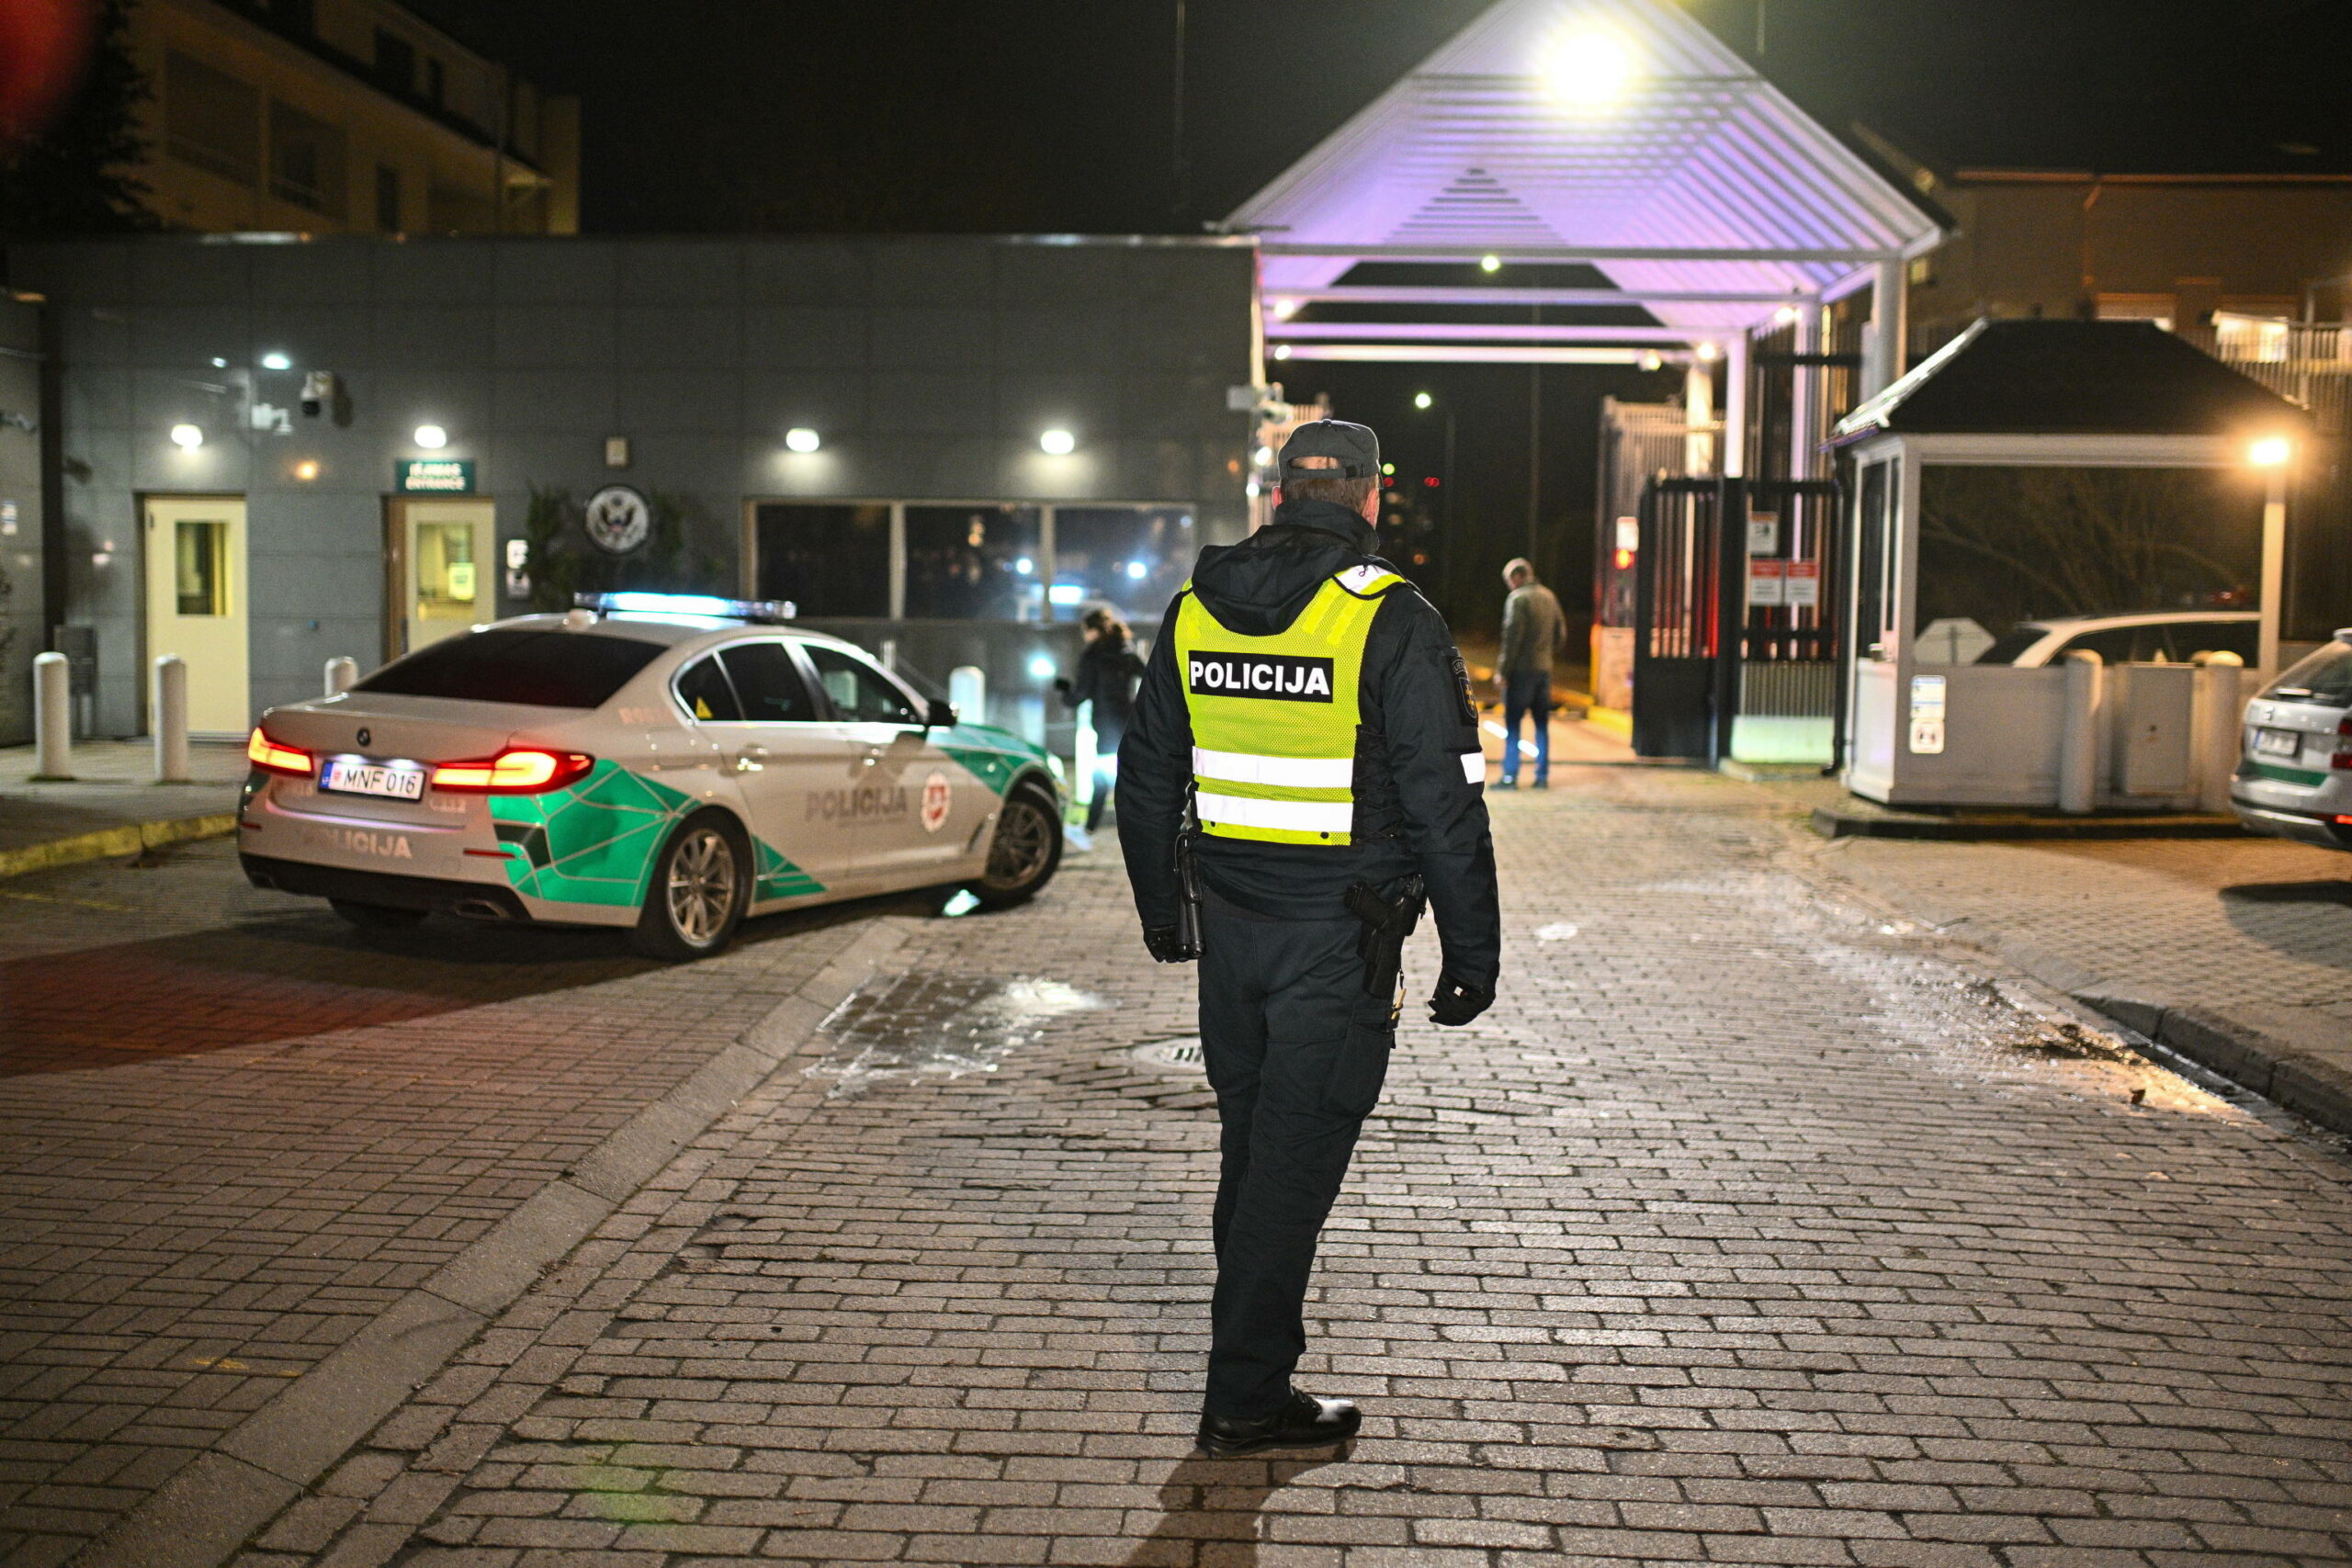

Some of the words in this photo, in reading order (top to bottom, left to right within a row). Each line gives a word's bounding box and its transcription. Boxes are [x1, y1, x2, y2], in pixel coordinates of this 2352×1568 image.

[1190, 660, 1330, 695] POLICIJA
[344, 769, 384, 789] MNF
[386, 773, 416, 795] 016
[805, 787, 908, 822] POLICIJA
